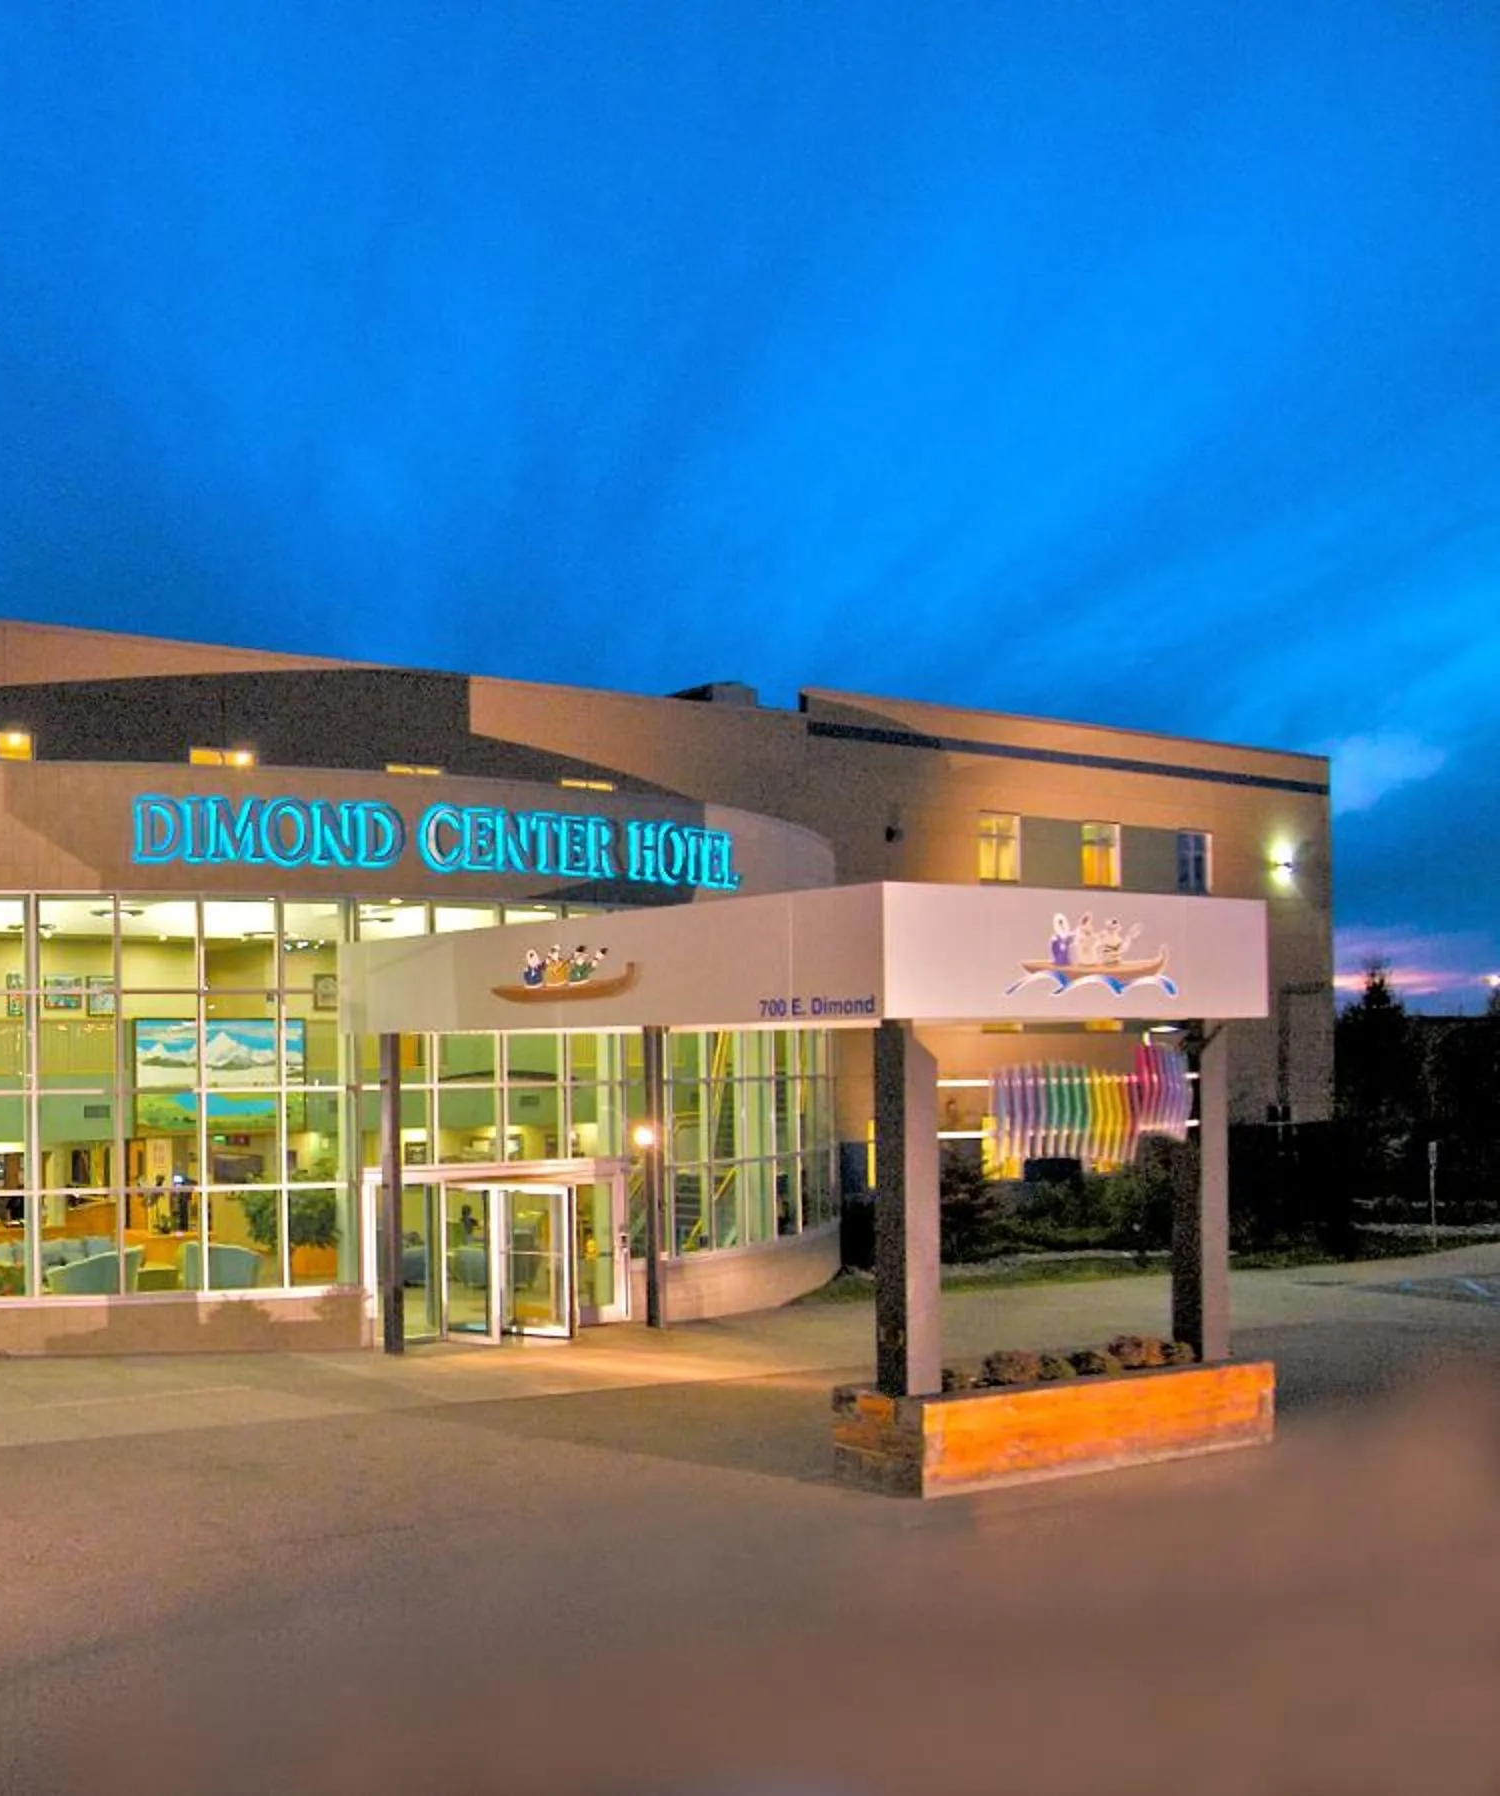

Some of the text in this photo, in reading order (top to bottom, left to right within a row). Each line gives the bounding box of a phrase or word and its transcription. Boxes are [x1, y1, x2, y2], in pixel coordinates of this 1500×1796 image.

[131, 793, 740, 890] DIMOND CENTER HOTEL
[760, 999, 786, 1017] 700
[811, 995, 875, 1015] Dimond
